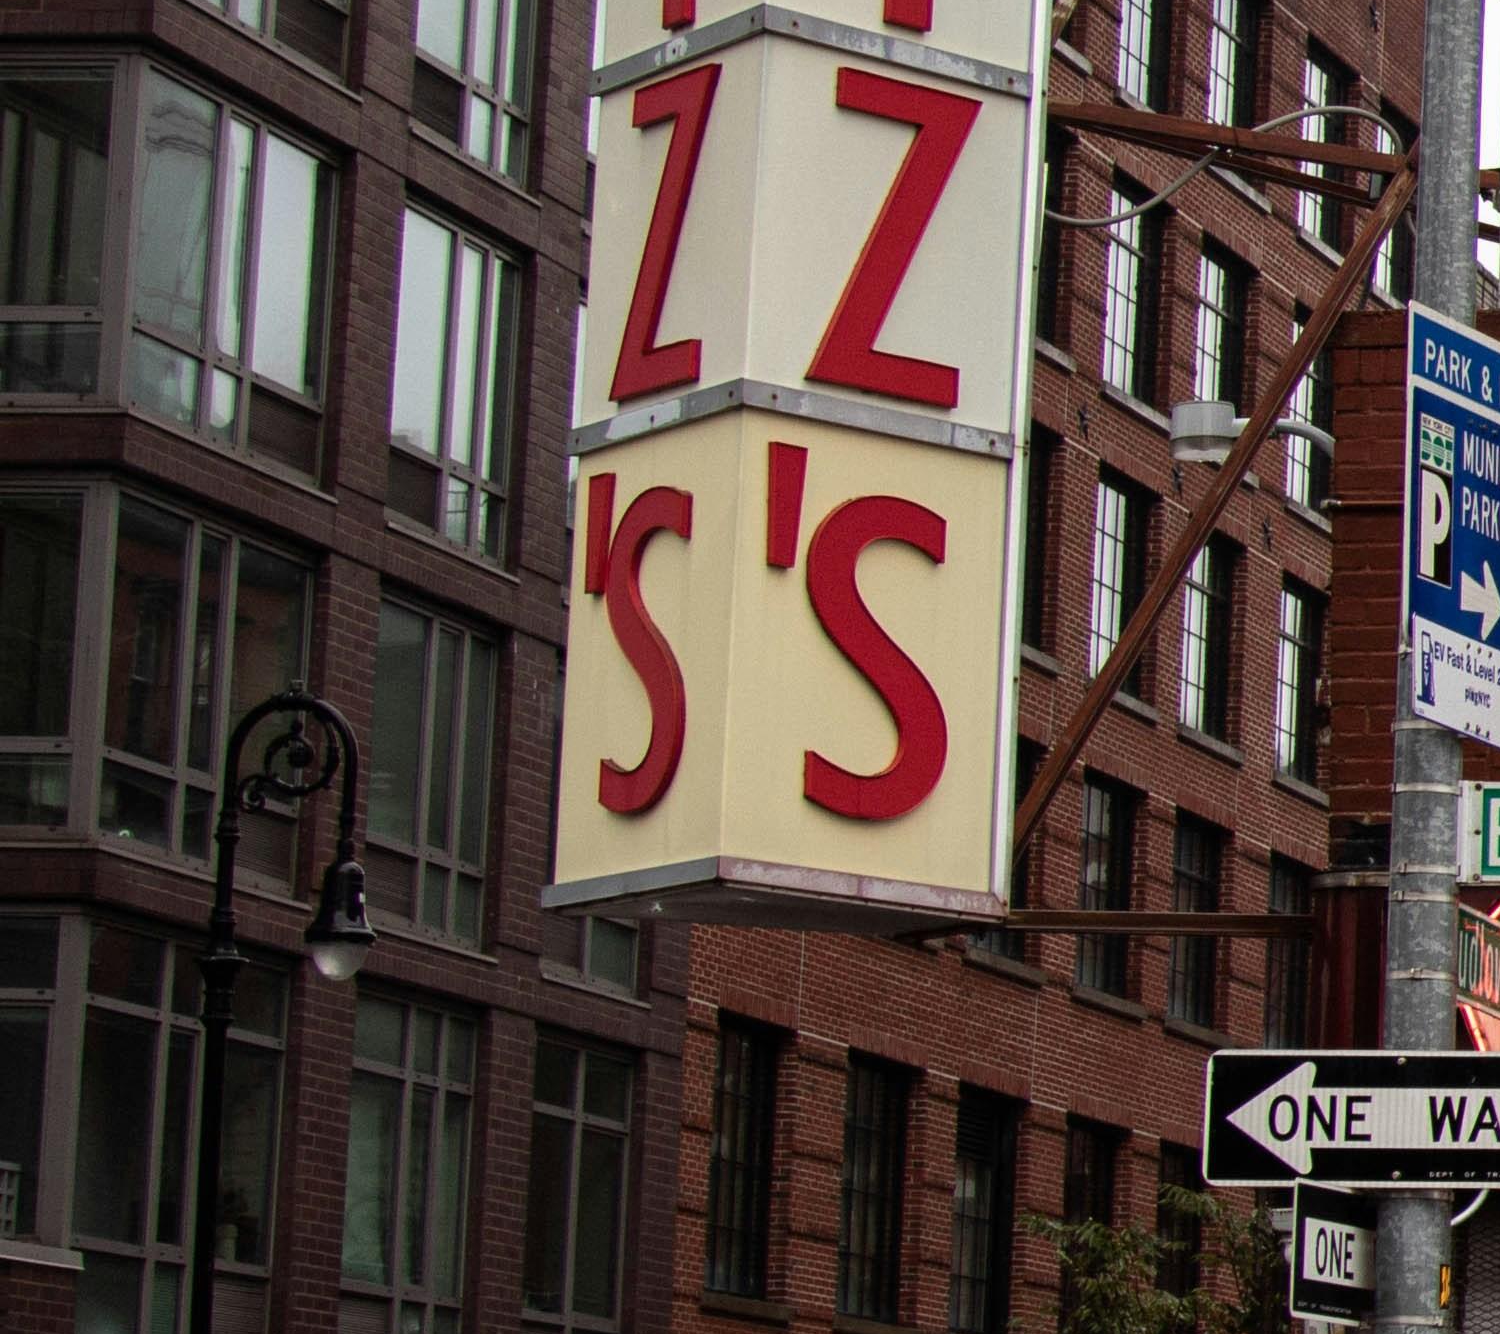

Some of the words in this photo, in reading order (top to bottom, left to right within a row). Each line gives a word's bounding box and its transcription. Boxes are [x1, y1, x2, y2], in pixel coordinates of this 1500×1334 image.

[1425, 338, 1472, 393] PARK
[1481, 366, 1493, 403] &
[1420, 468, 1450, 578] P
[1434, 641, 1445, 662] EV
[1447, 646, 1464, 669] Fast
[1466, 655, 1473, 669] &
[1474, 657, 1495, 684] Level
[1268, 1094, 1372, 1143] ONE
[1315, 1227, 1355, 1281] ONE
